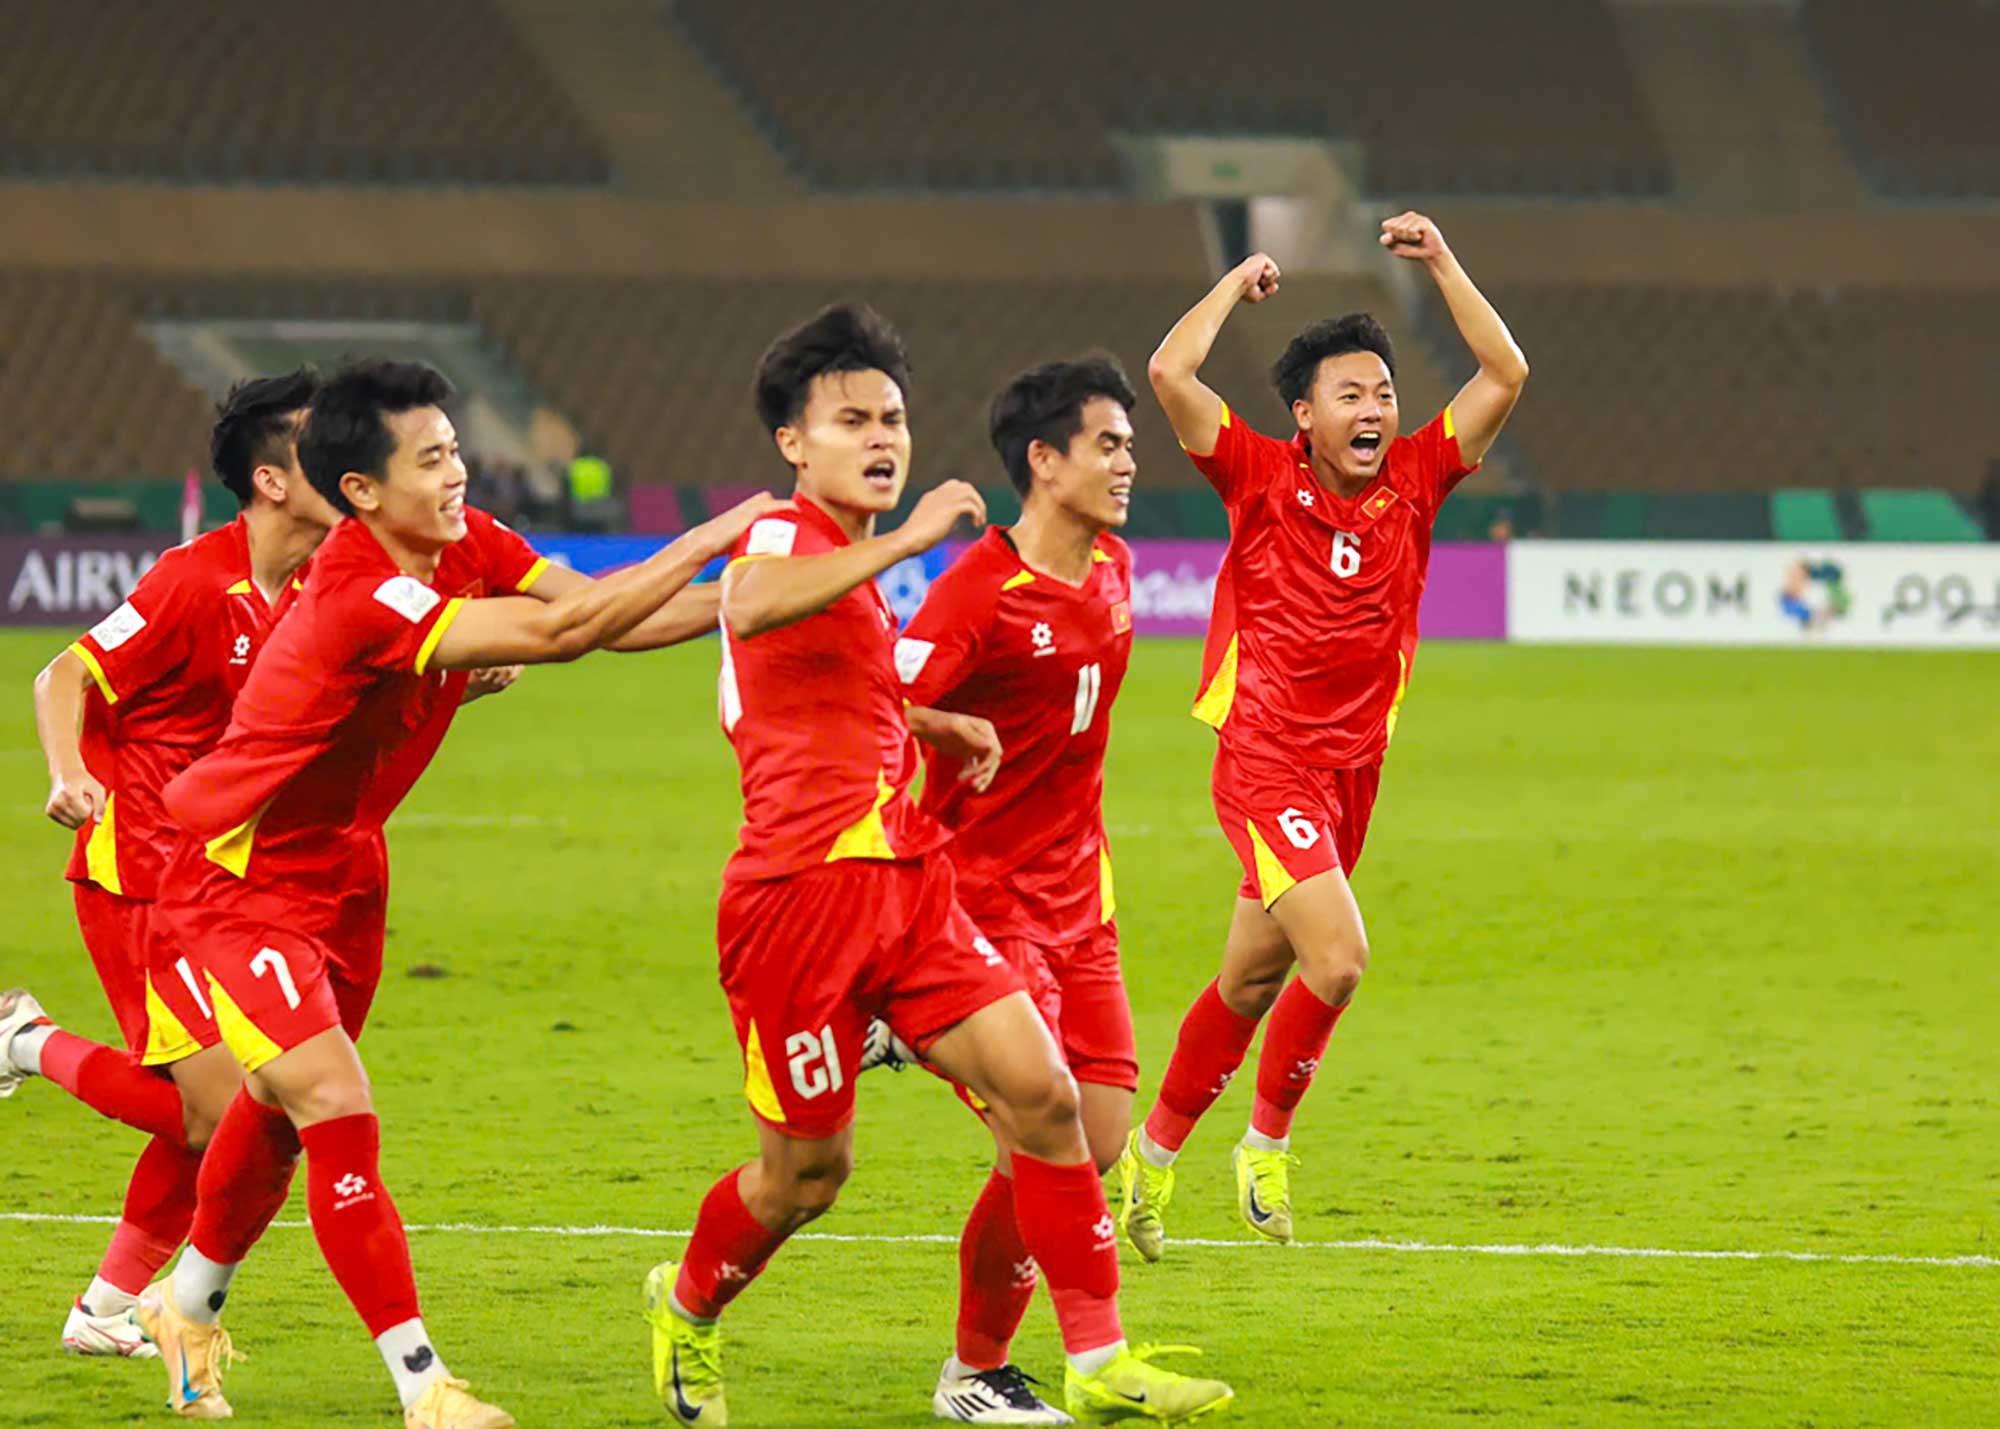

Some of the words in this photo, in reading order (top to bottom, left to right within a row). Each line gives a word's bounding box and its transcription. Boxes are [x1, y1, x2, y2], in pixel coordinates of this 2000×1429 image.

[1330, 530, 1361, 578] 6
[1563, 570, 1749, 616] NEOM
[1070, 662, 1101, 735] 11
[1277, 807, 1321, 850] 6
[249, 946, 301, 1011] 7
[785, 1023, 844, 1100] 21
